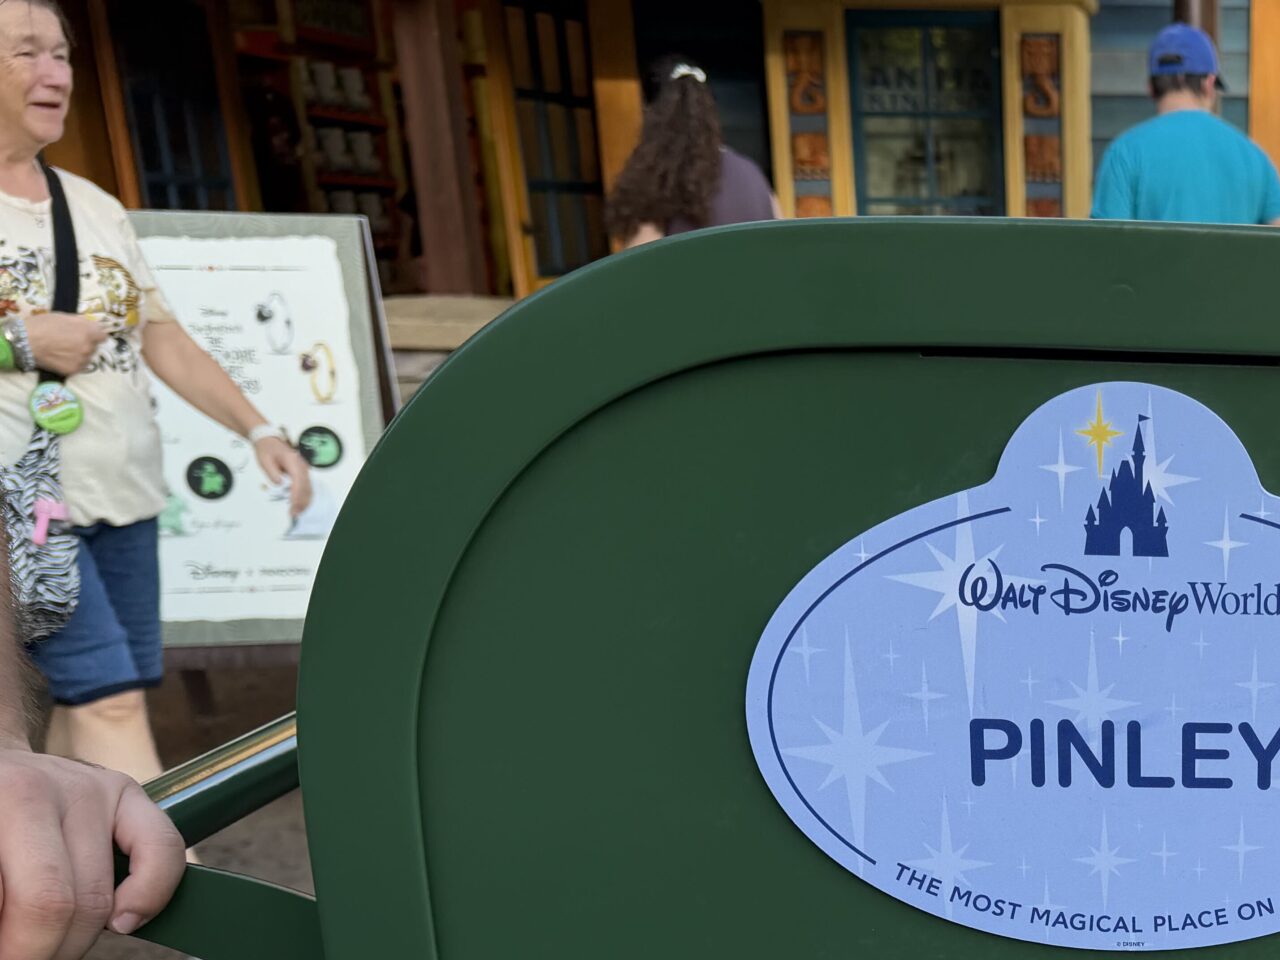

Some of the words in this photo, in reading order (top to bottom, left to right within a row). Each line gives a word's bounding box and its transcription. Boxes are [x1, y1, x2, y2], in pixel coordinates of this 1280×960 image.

[895, 862, 942, 897] THE
[949, 885, 1022, 920] MOST
[1030, 906, 1143, 933] MAGICAL
[1153, 908, 1229, 933] PLACE
[1237, 897, 1275, 922] ON
